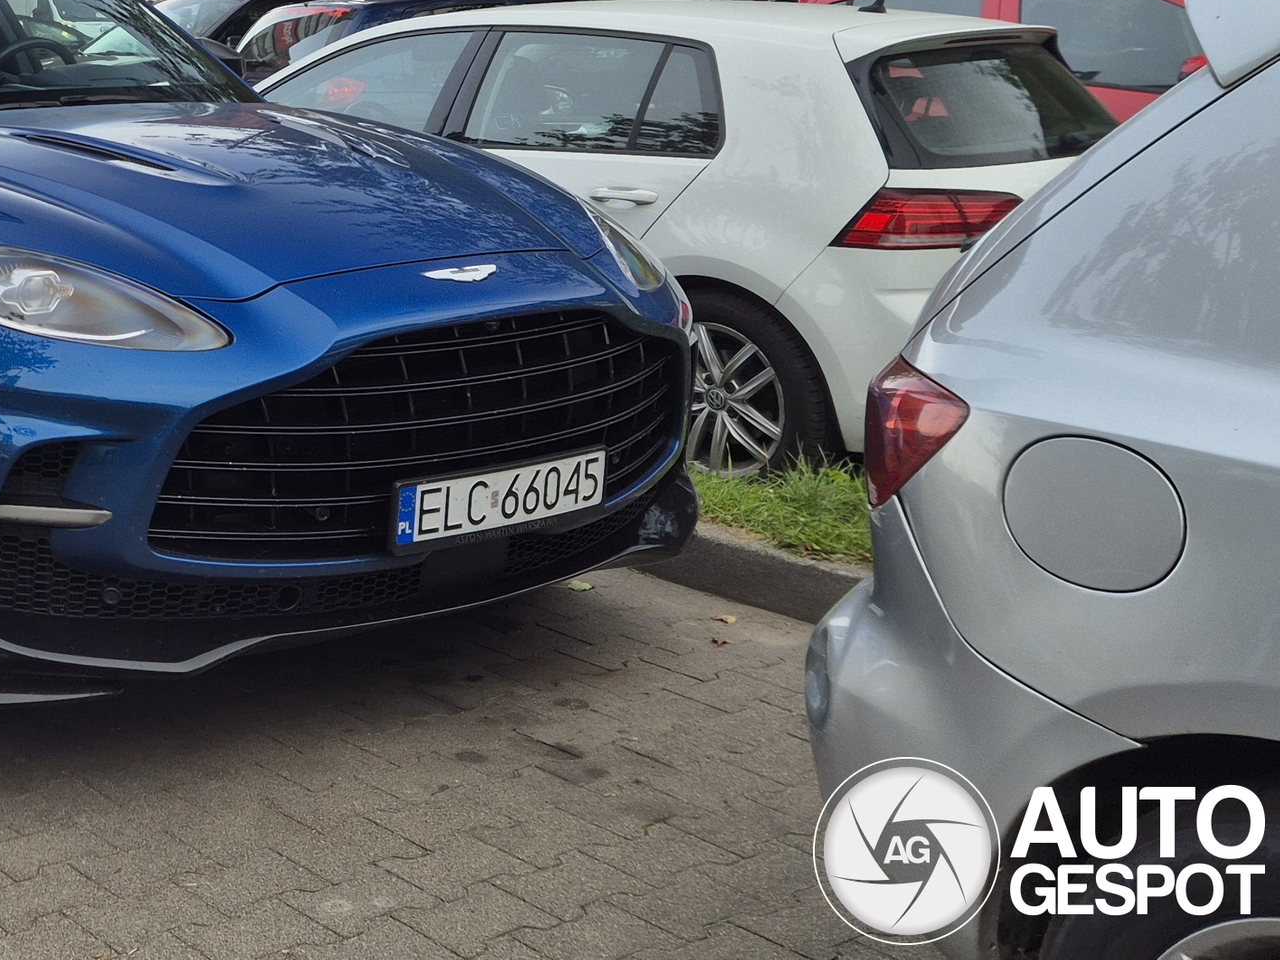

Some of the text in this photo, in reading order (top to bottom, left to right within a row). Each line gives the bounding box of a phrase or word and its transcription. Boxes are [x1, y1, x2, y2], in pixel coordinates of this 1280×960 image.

[417, 456, 600, 535] ELC 66045
[397, 520, 413, 536] PL
